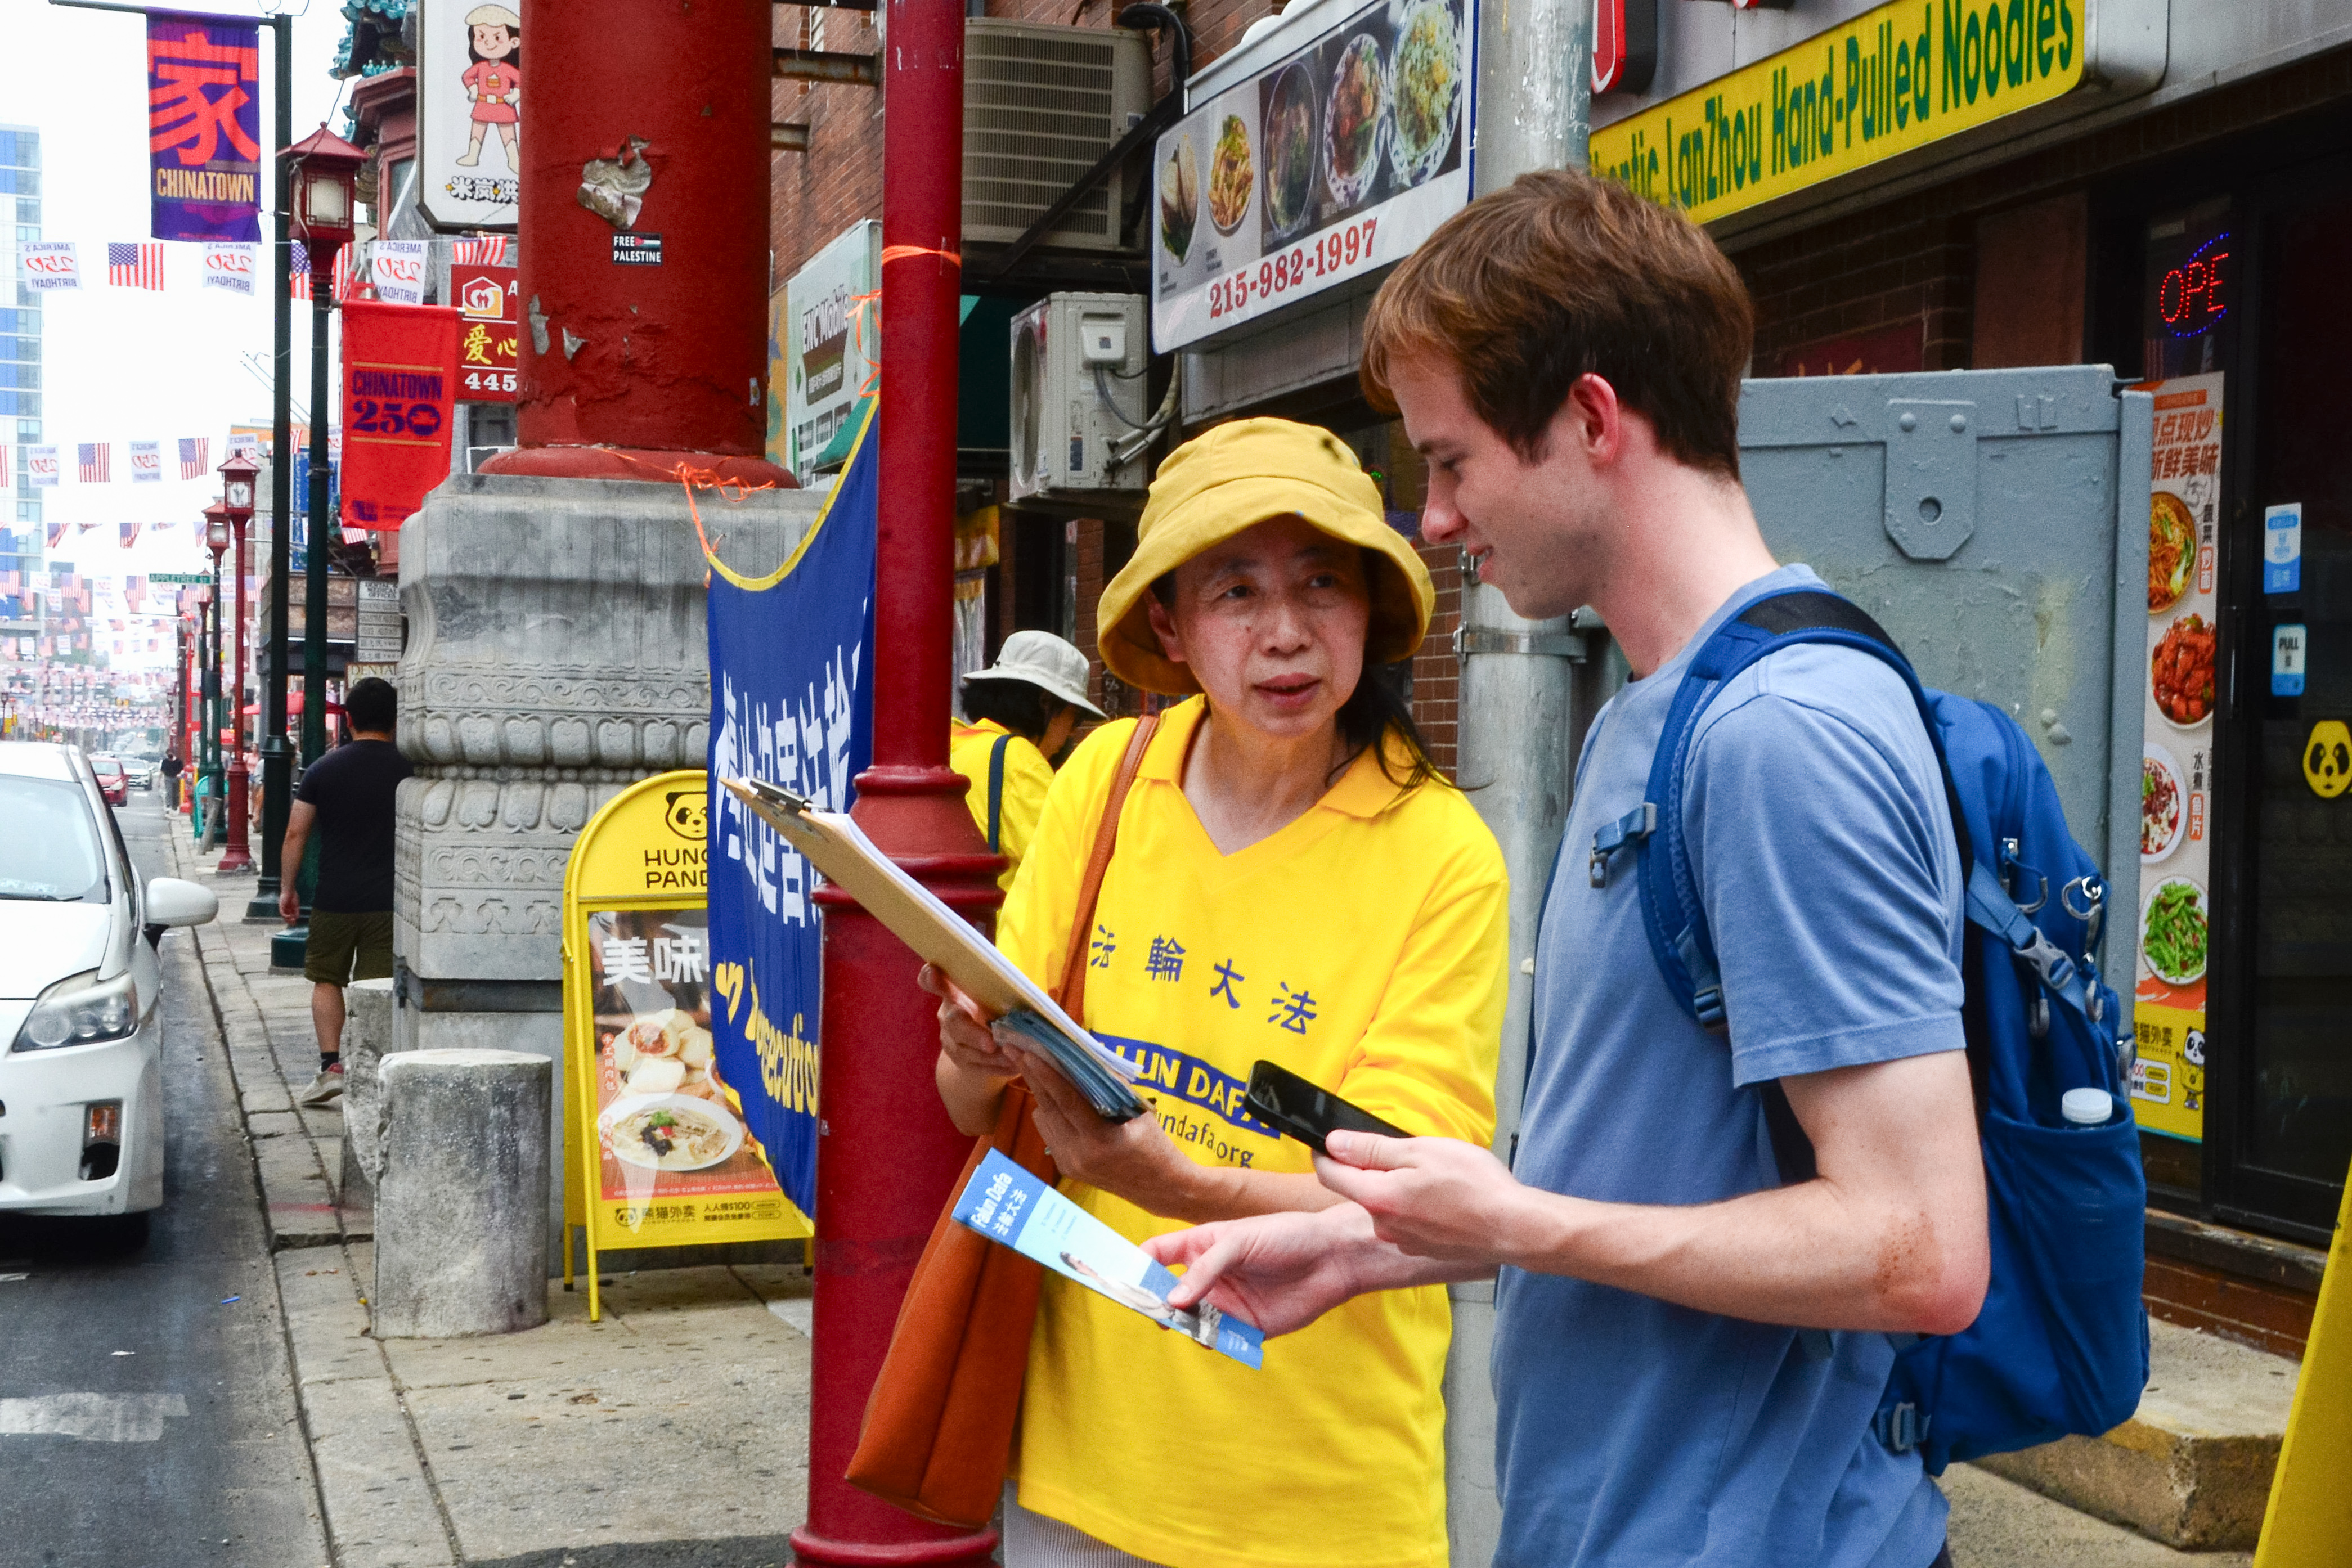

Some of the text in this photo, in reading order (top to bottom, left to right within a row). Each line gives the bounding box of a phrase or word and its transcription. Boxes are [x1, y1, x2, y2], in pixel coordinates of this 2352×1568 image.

[149, 32, 261, 165] 家
[1667, 94, 1761, 209] LanZhou
[1772, 2, 1931, 176] Hand-Pulled
[1942, 0, 2073, 114] Noodles
[156, 168, 254, 203] CHINATOWN
[613, 236, 635, 246] FREE
[613, 250, 661, 263] PALESTINE
[1210, 217, 1378, 318] 215-982-1997
[2160, 253, 2229, 322] OPE
[464, 324, 517, 365] 爱心
[352, 370, 442, 400] CHINATOWN
[465, 372, 517, 392] 445
[352, 399, 441, 436] 250
[2279, 636, 2299, 650] PULL
[602, 934, 709, 986] 美味
[1090, 924, 1318, 1035] 法輪大法
[1186, 1066, 1270, 1129] DAF
[969, 1169, 1013, 1228] Falun Dafa
